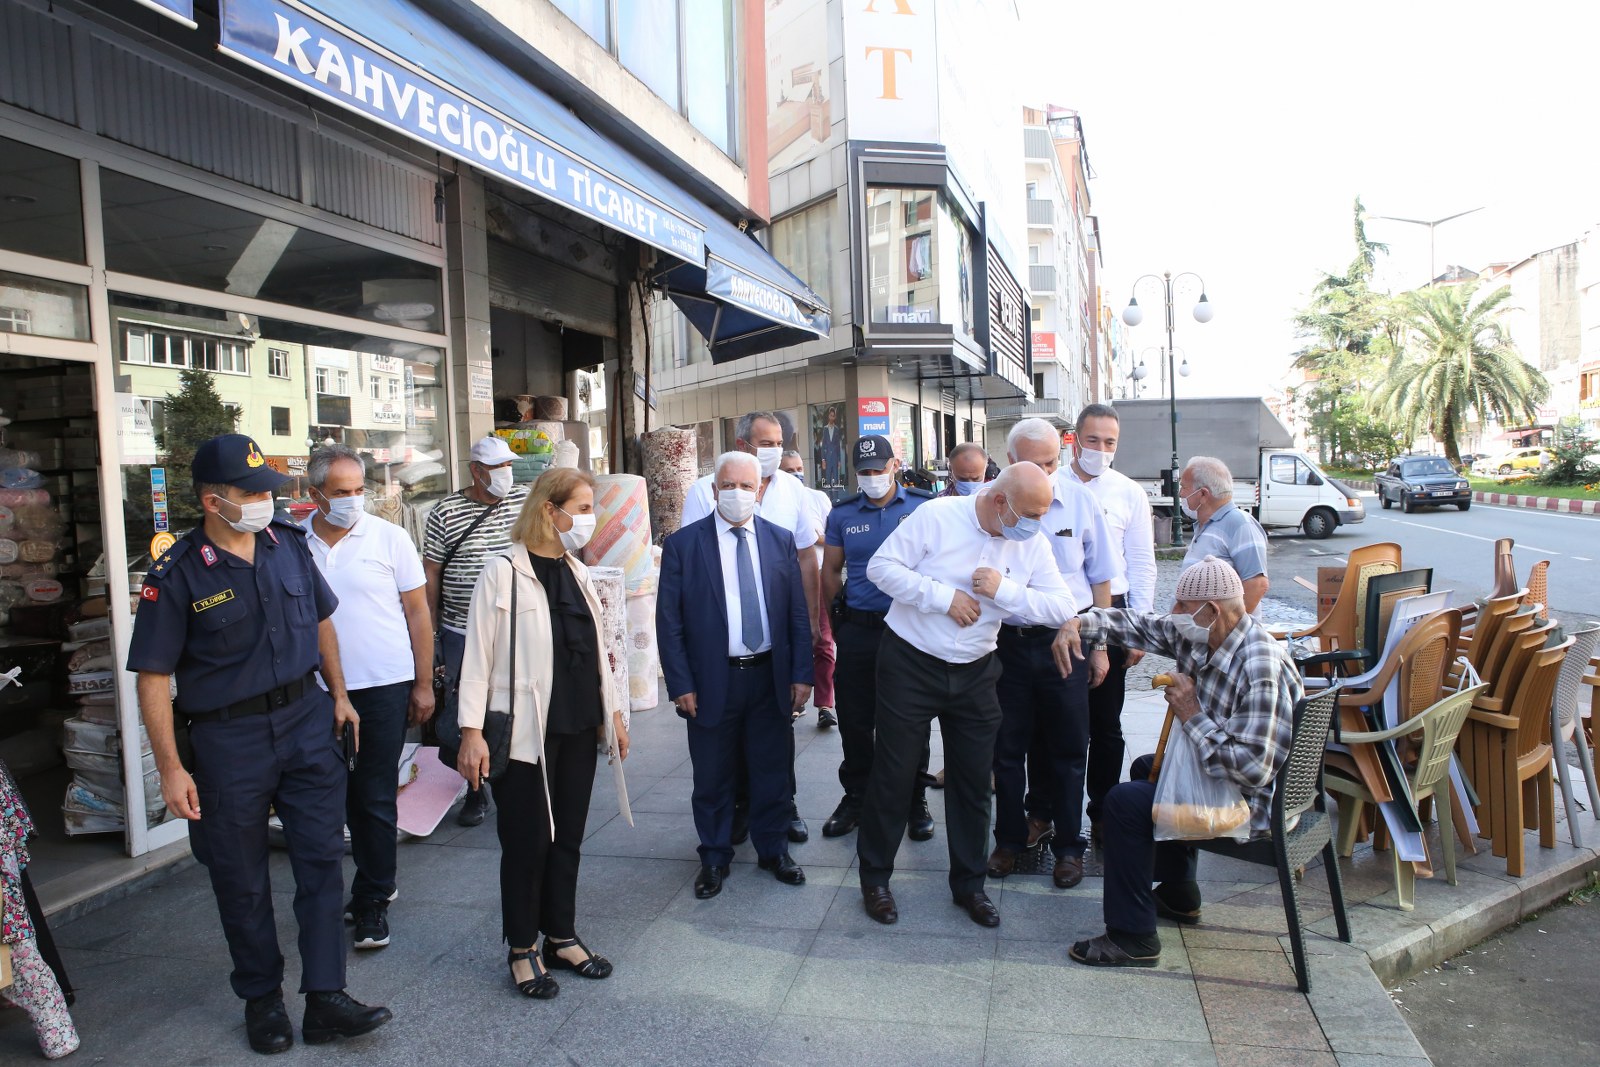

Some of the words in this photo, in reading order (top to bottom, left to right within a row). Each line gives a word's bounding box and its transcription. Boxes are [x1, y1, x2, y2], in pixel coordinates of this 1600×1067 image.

[273, 12, 557, 191] KAHVECİOĞLU
[567, 167, 658, 237] TİCARET
[892, 309, 931, 323] mavi
[863, 421, 886, 431] mavi
